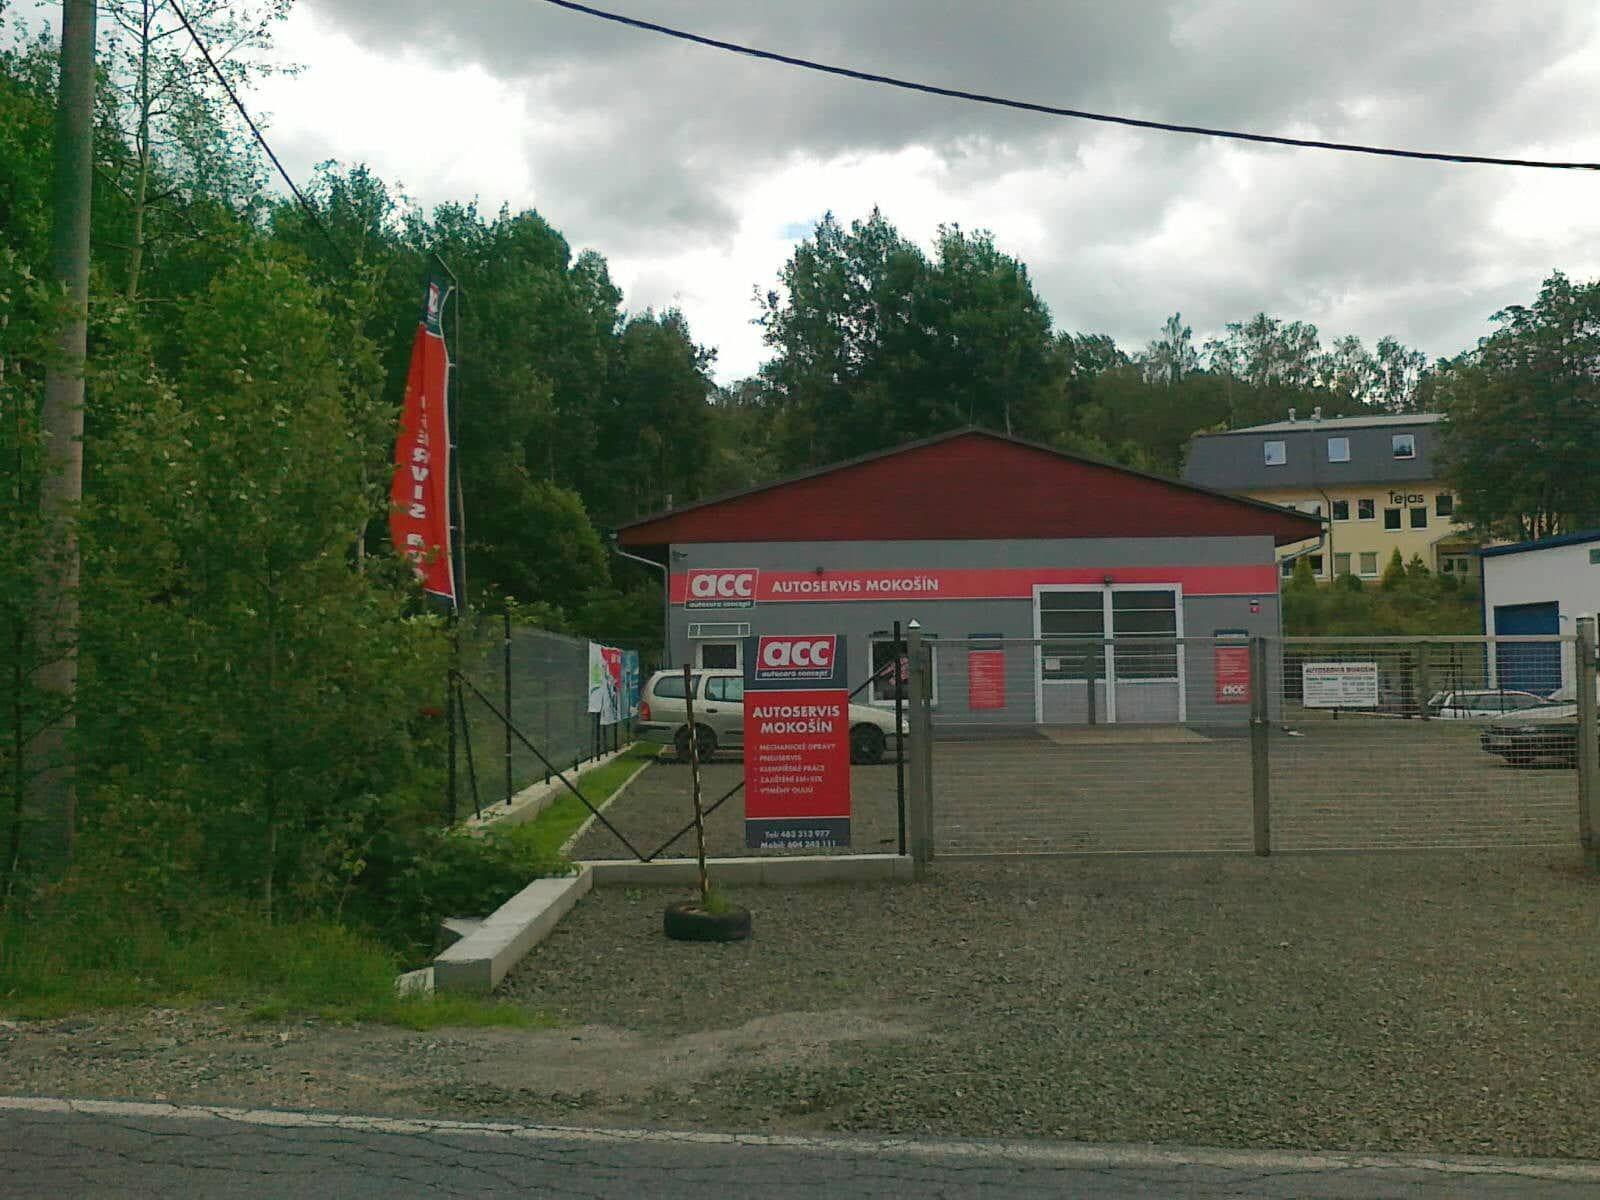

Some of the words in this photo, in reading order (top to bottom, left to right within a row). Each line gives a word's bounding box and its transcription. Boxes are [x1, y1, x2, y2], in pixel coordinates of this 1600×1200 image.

[1384, 488, 1425, 509] Tejas
[691, 573, 753, 598] acc
[772, 580, 861, 593] AUTOSERVIS
[866, 576, 939, 592] MOKOŠÍN
[763, 640, 830, 667] acc
[752, 705, 841, 719] AUTOSERVIS
[760, 718, 833, 734] MOKOŠÍN
